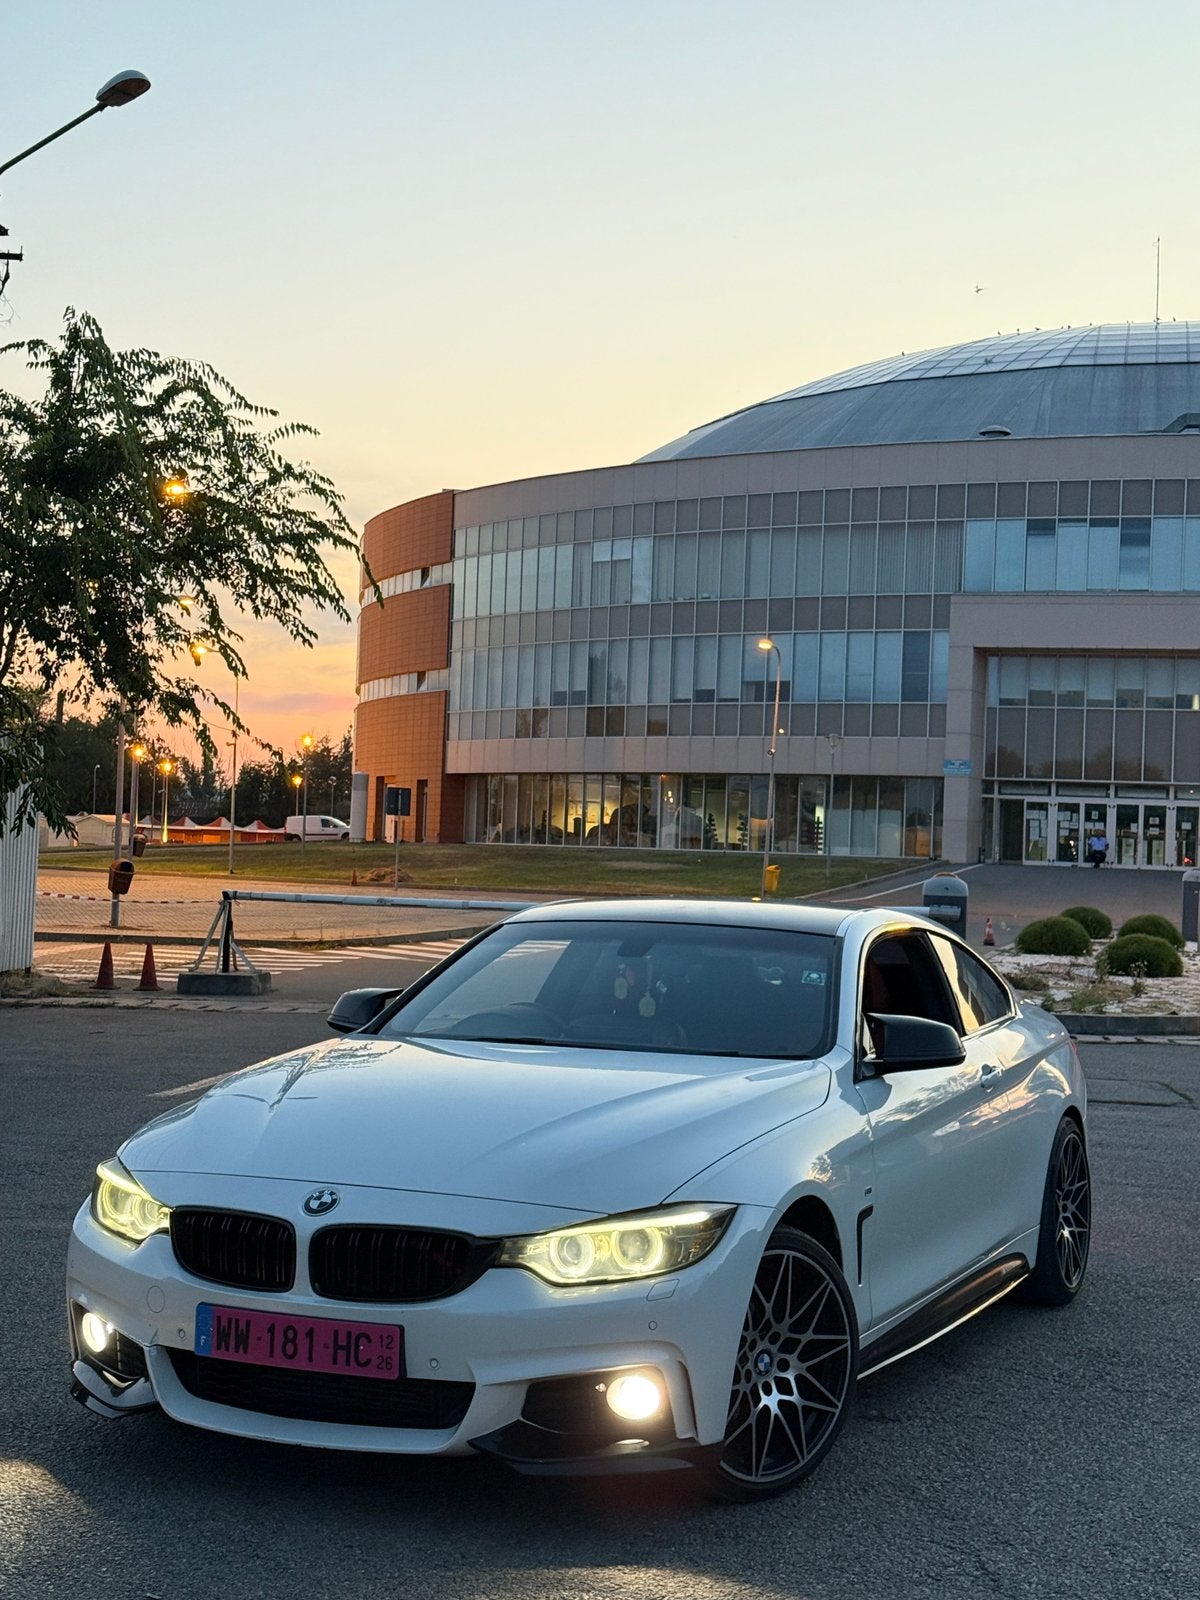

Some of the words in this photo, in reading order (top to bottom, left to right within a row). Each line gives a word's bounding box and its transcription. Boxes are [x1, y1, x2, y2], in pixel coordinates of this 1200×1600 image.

[200, 1335, 207, 1346] F
[379, 1334, 394, 1350] 12
[376, 1355, 393, 1371] 26
